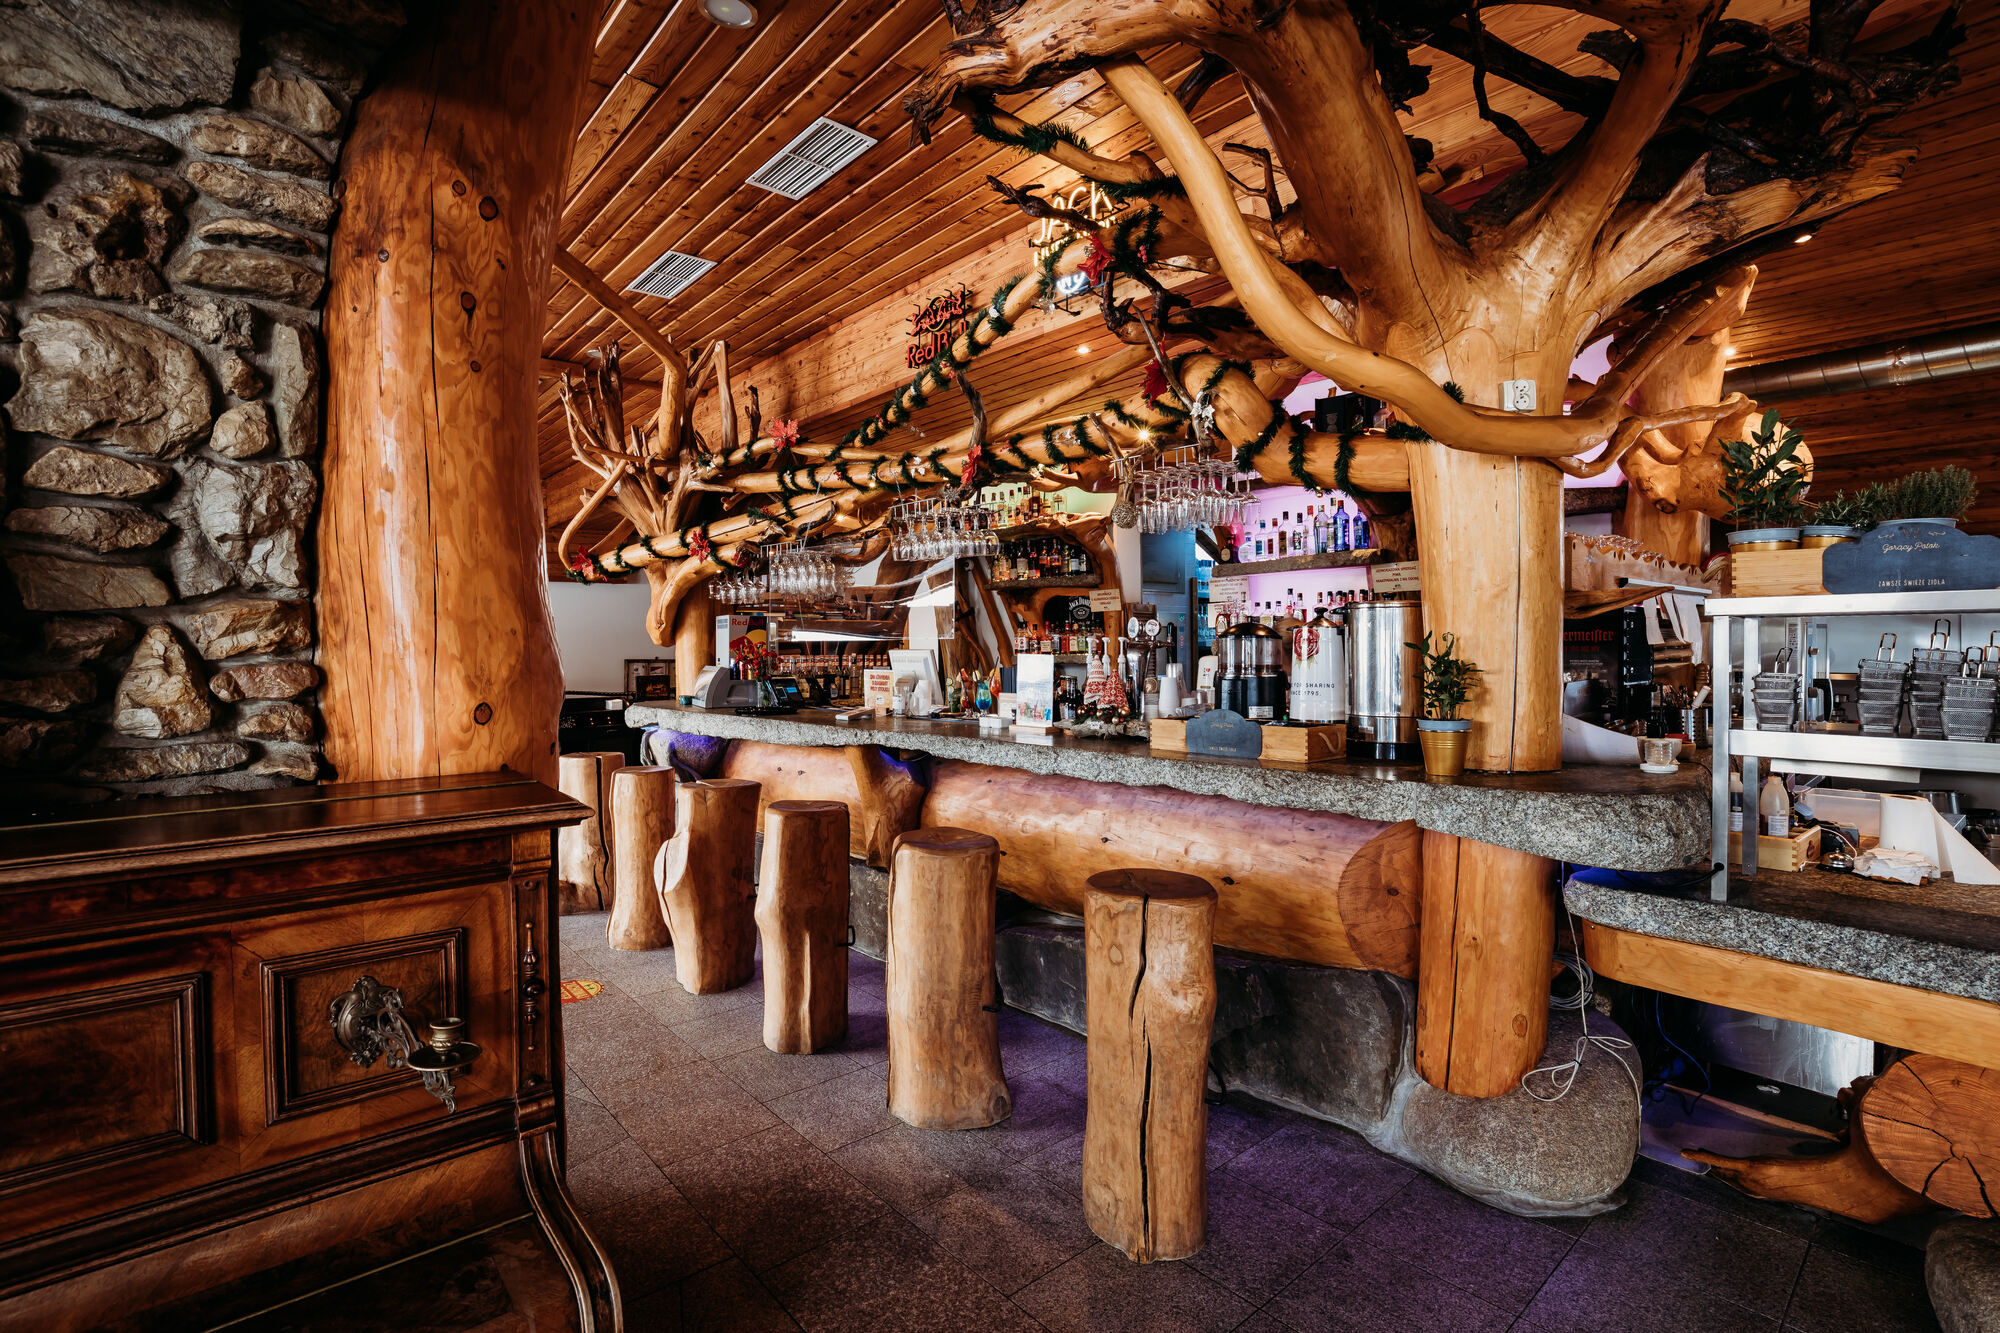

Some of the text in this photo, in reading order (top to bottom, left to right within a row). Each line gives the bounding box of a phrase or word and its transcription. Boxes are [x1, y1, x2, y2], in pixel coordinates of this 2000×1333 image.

[907, 320, 967, 368] Red Bll
[1882, 541, 1940, 554] Gorący Potok
[731, 618, 748, 626] Red
[1563, 629, 1614, 643] ermeister
